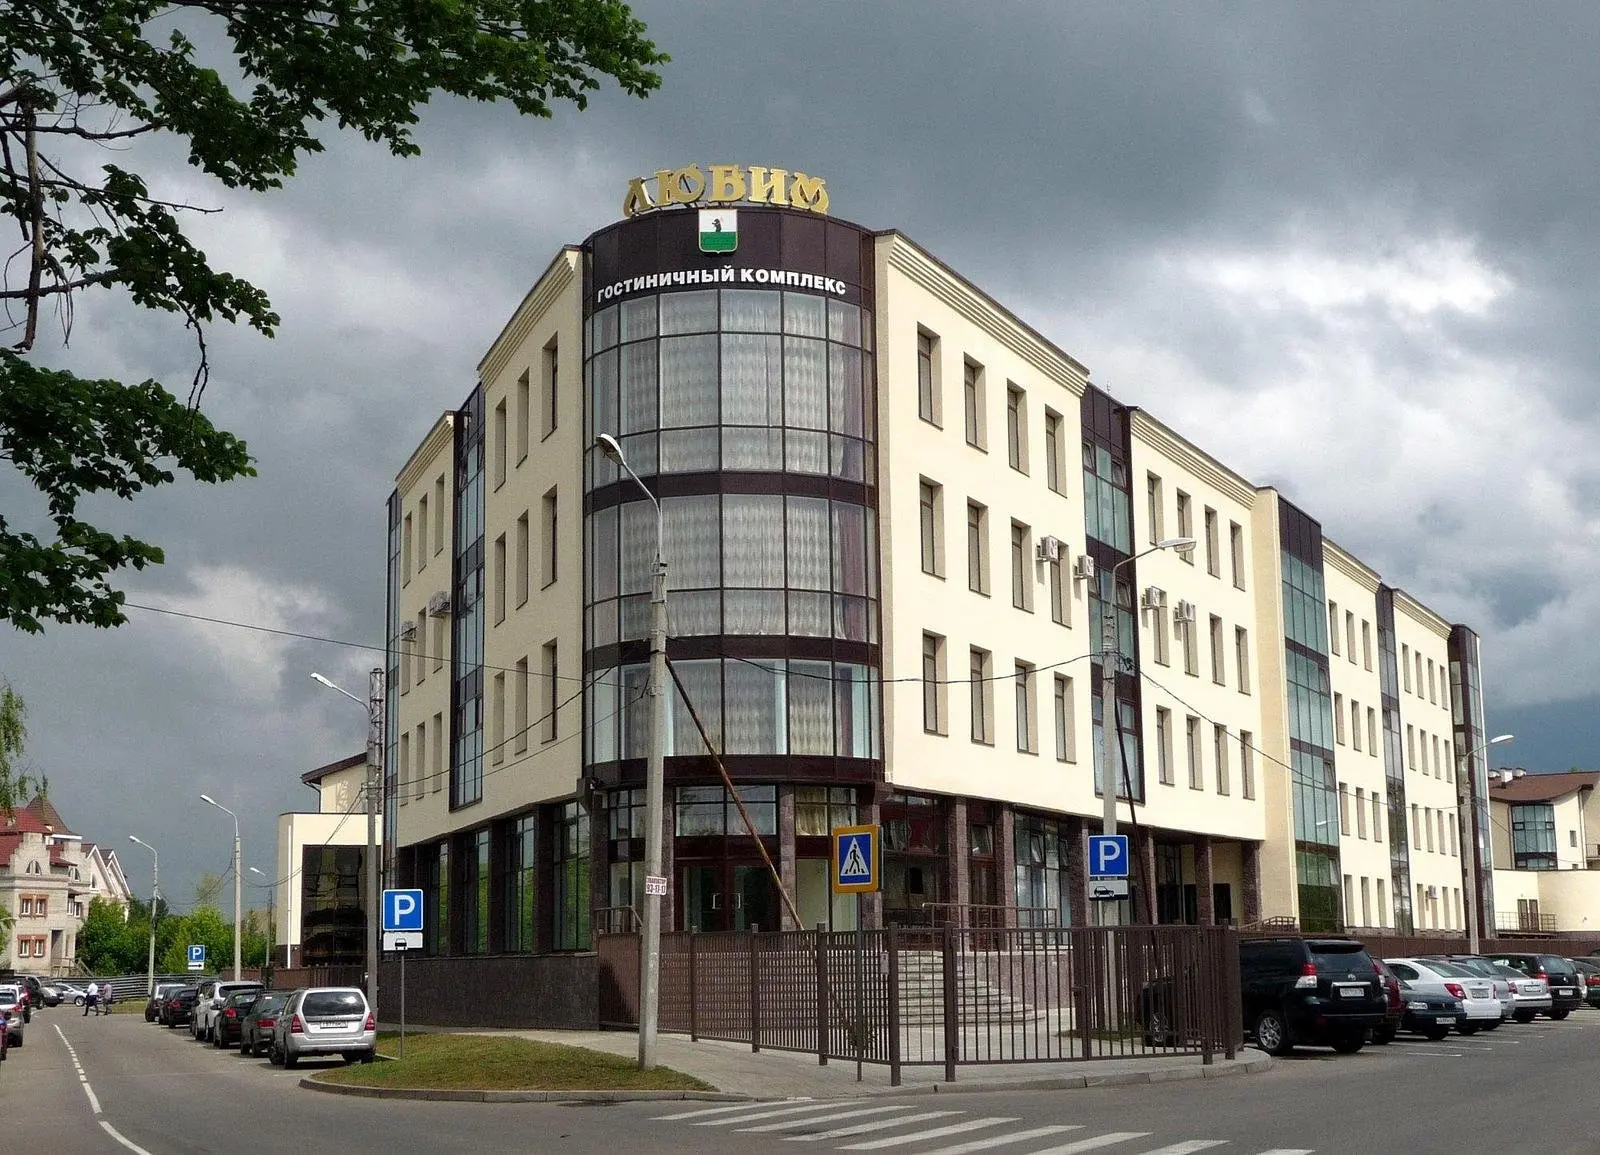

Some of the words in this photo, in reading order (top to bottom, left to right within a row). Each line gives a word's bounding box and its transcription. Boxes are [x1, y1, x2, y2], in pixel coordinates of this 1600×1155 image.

[623, 163, 829, 218] ЛЮБИМ
[597, 265, 735, 302] ГОСТИНИЧНЫЙ
[741, 268, 846, 295] КОМПЛЕКС
[1100, 841, 1120, 871] P
[395, 895, 415, 925] P
[192, 947, 201, 960] P
